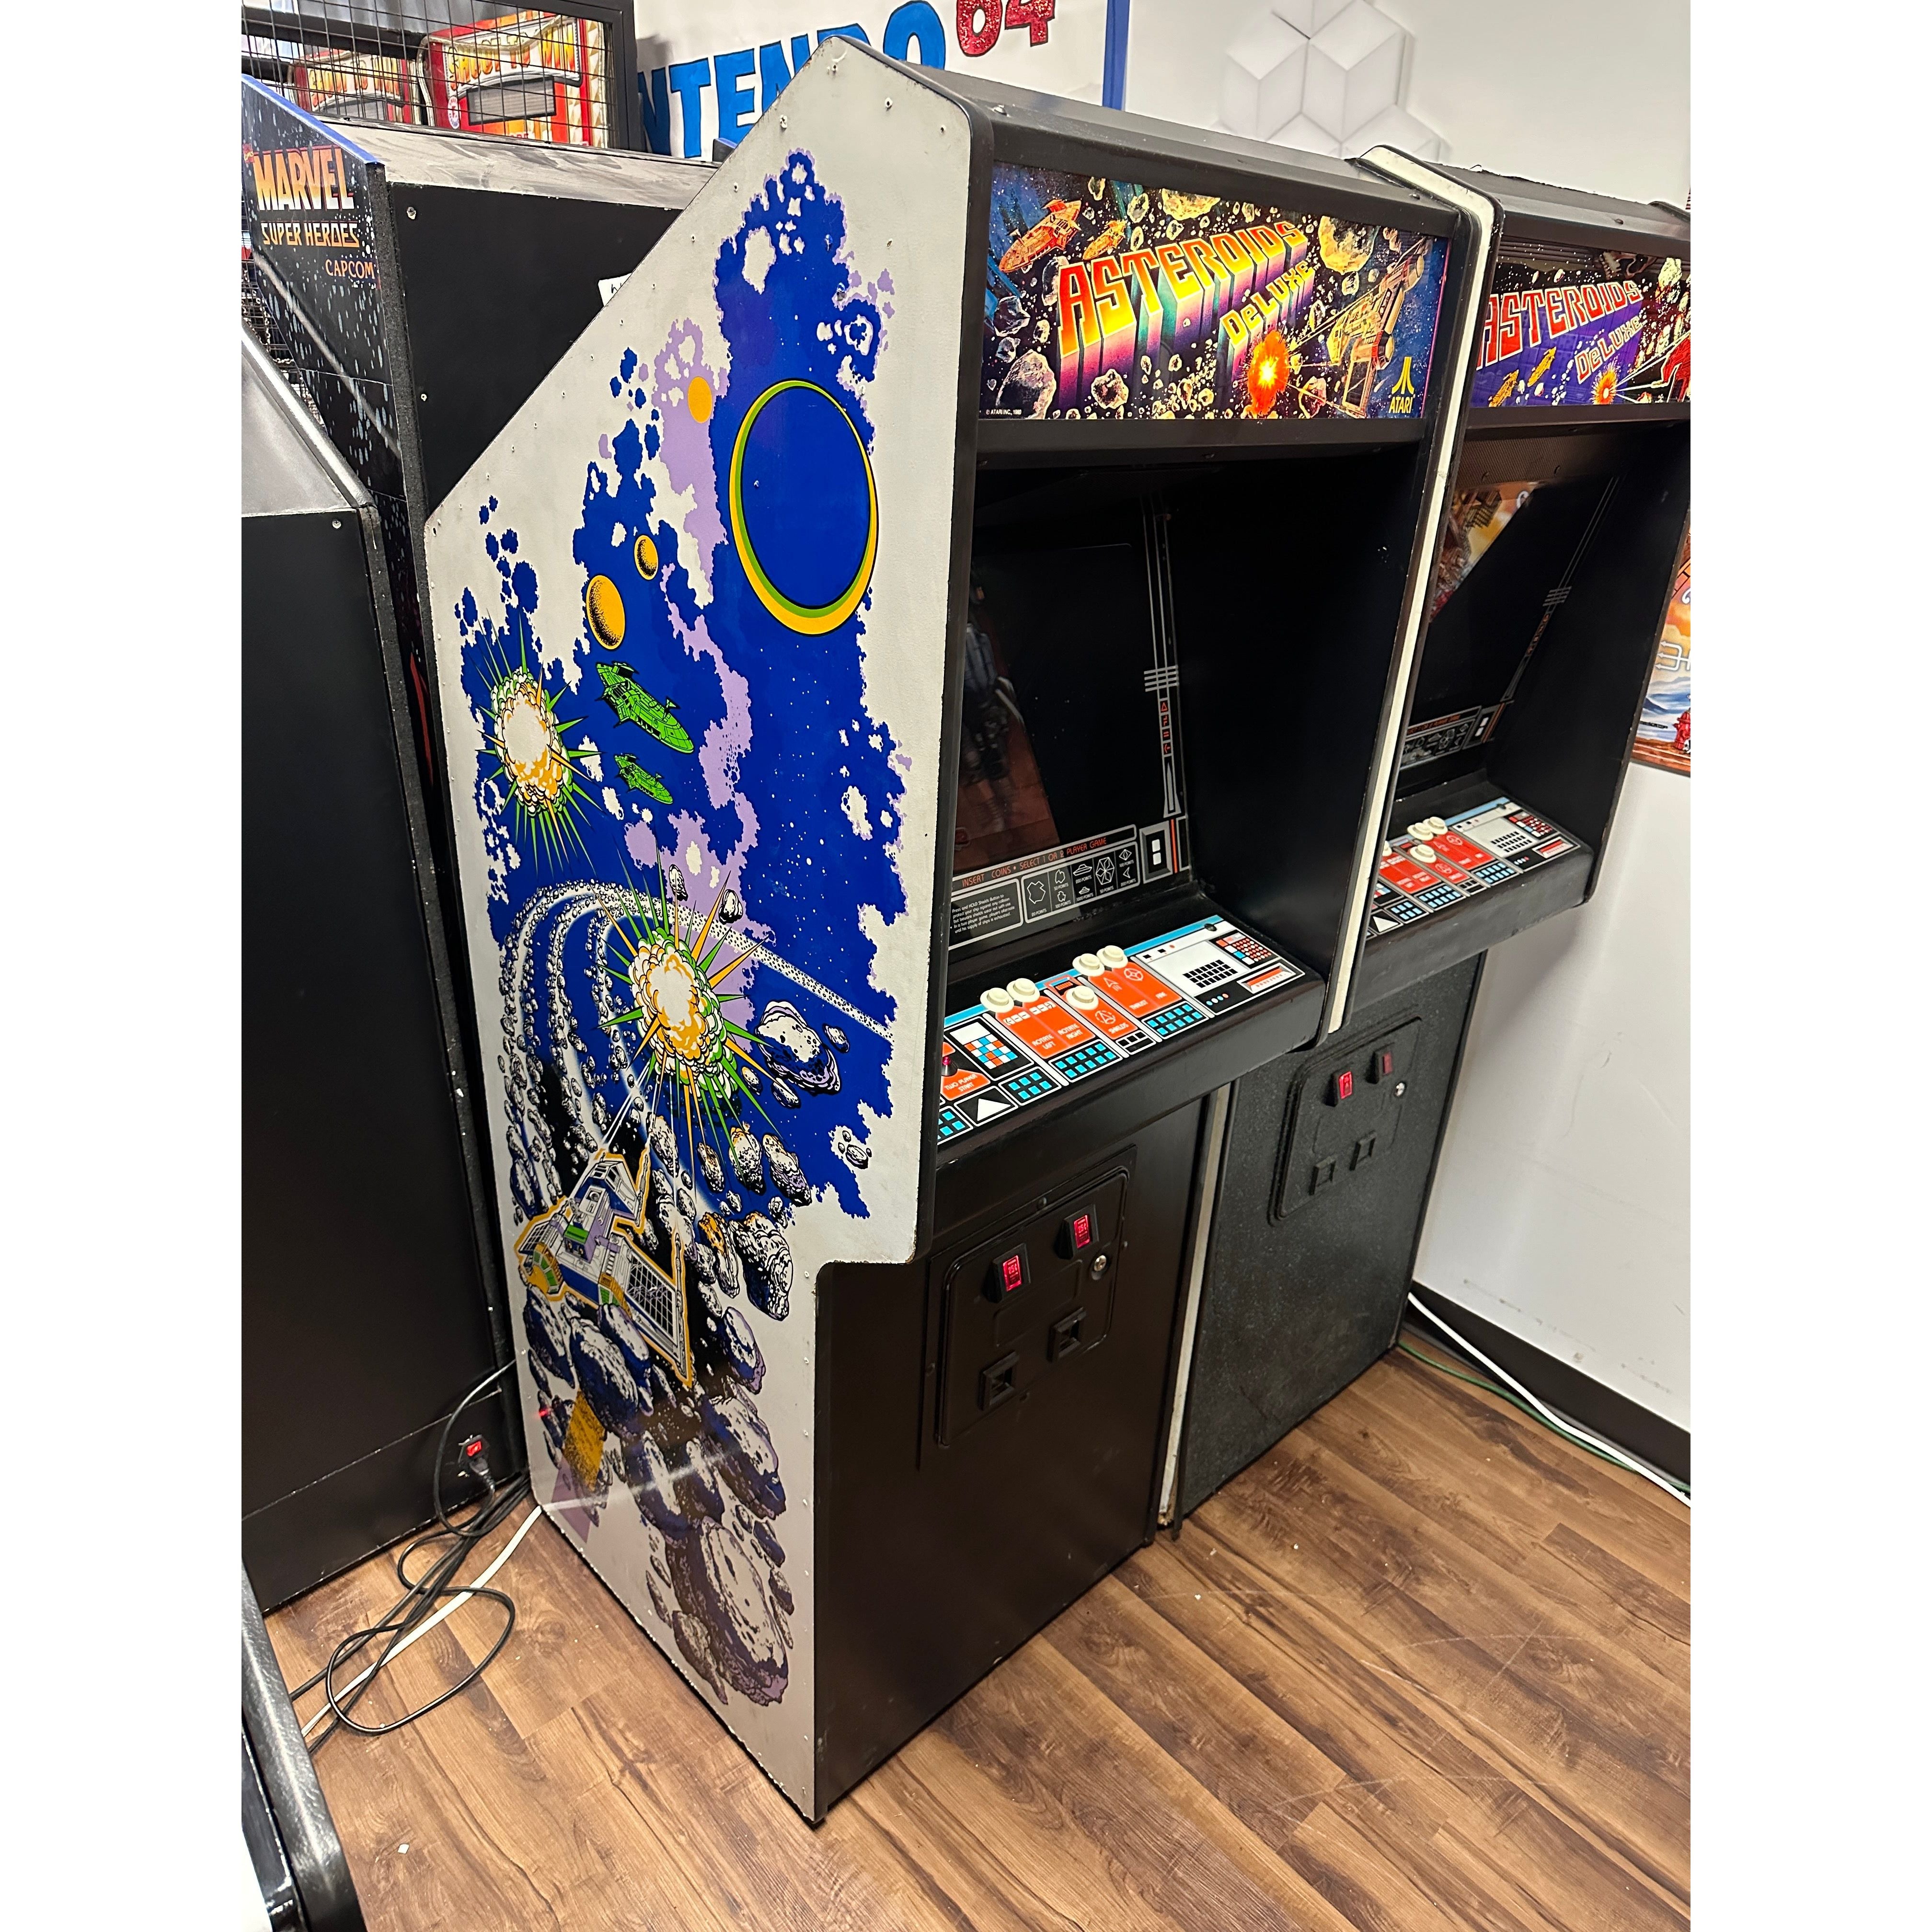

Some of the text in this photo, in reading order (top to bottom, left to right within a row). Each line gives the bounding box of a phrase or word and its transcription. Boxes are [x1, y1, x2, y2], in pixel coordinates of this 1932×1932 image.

[252, 144, 355, 211] MARVEL
[261, 221, 360, 248] SUPER HEROES
[325, 259, 375, 280] CAPCOM
[1057, 221, 1306, 358] ASTEROIDS
[1476, 280, 1644, 371] ASTEROIDS
[1388, 396, 1413, 414] ATARI
[962, 874, 985, 887] INSERT
[991, 866, 1011, 878] COINS
[1019, 857, 1040, 870] SELECT
[1048, 852, 1058, 862] OR
[1067, 841, 1088, 855] PLAYER
[1089, 837, 1107, 849] GAME
[1058, 1023, 1080, 1035] ROTATE
[1066, 1029, 1083, 1040] RIGHT
[1031, 1034, 1054, 1046] ROTATE
[1042, 1040, 1056, 1050] LEFT
[944, 1073, 978, 1091] TWO PLAYER
[958, 1082, 975, 1092] START
